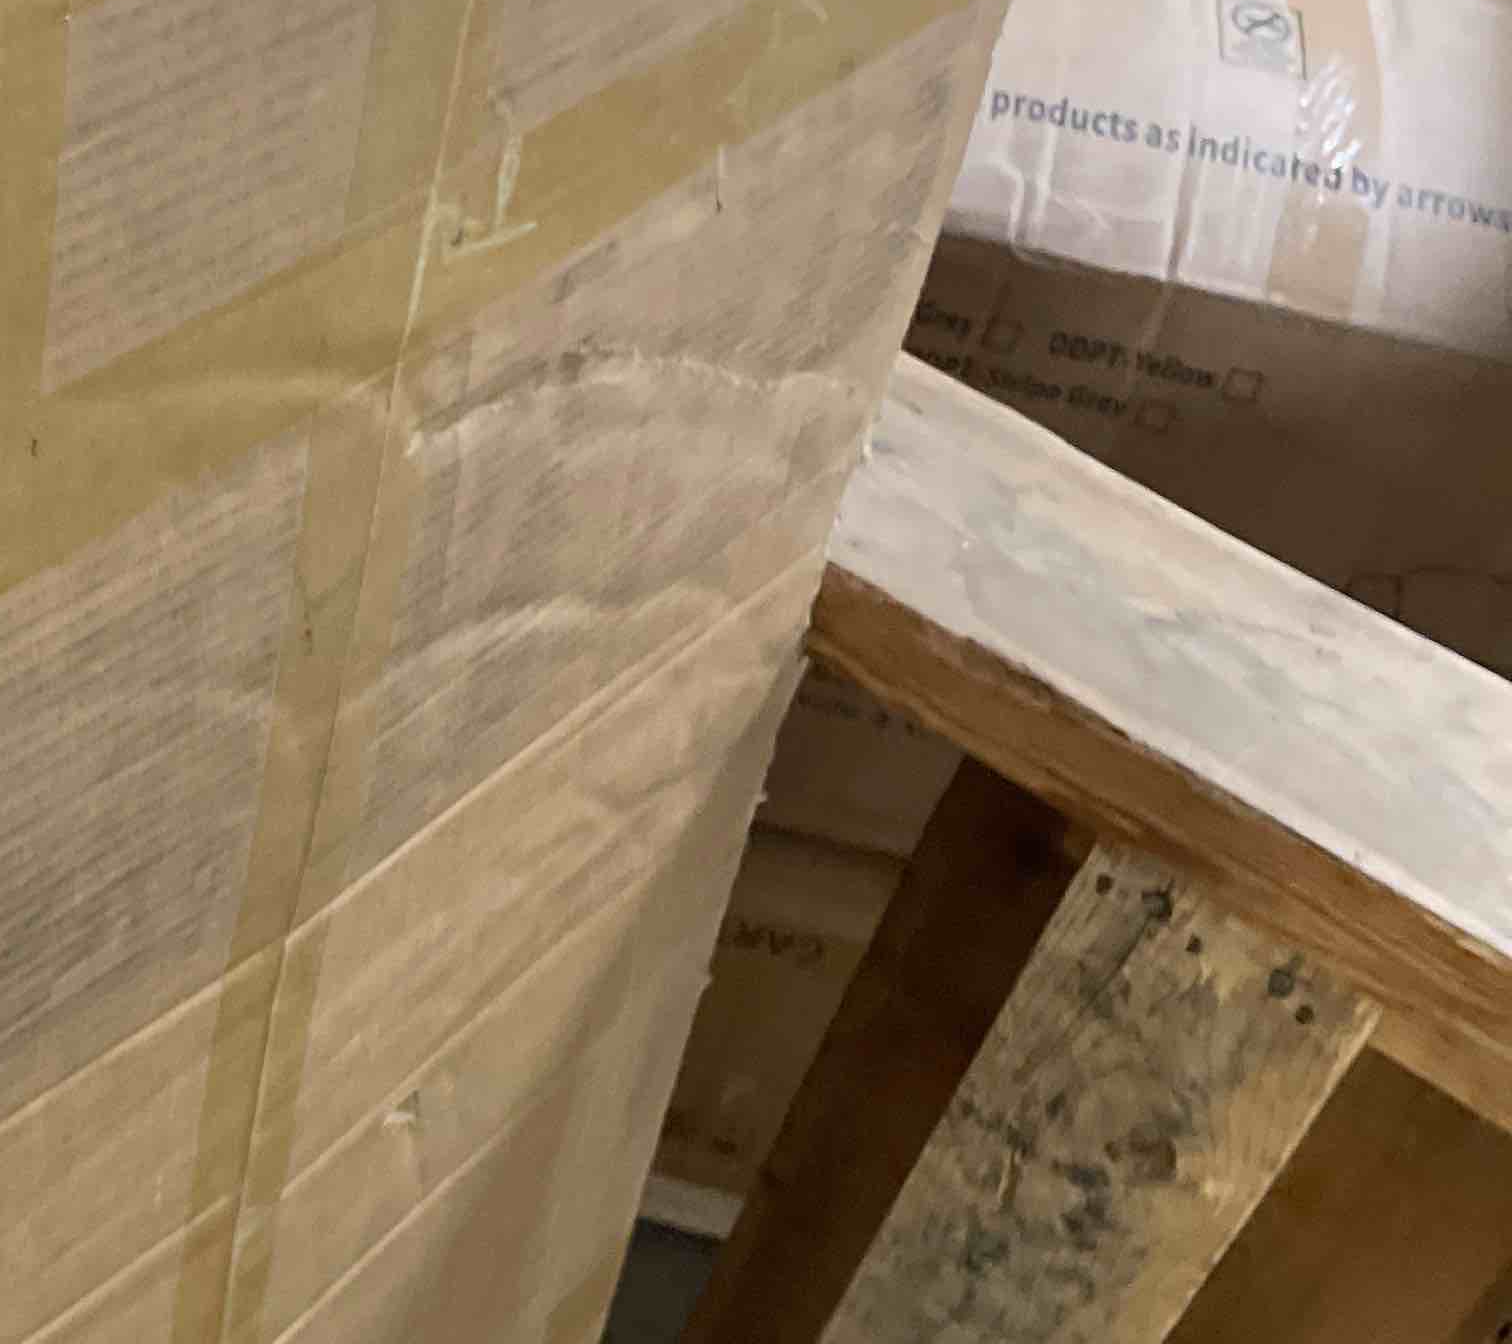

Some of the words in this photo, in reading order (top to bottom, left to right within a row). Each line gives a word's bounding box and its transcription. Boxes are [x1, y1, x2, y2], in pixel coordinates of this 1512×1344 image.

[990, 87, 1139, 143] products
[1144, 122, 1181, 154] as
[1188, 124, 1344, 190] indicated
[1351, 165, 1390, 209] by
[1395, 183, 1512, 234] arrows
